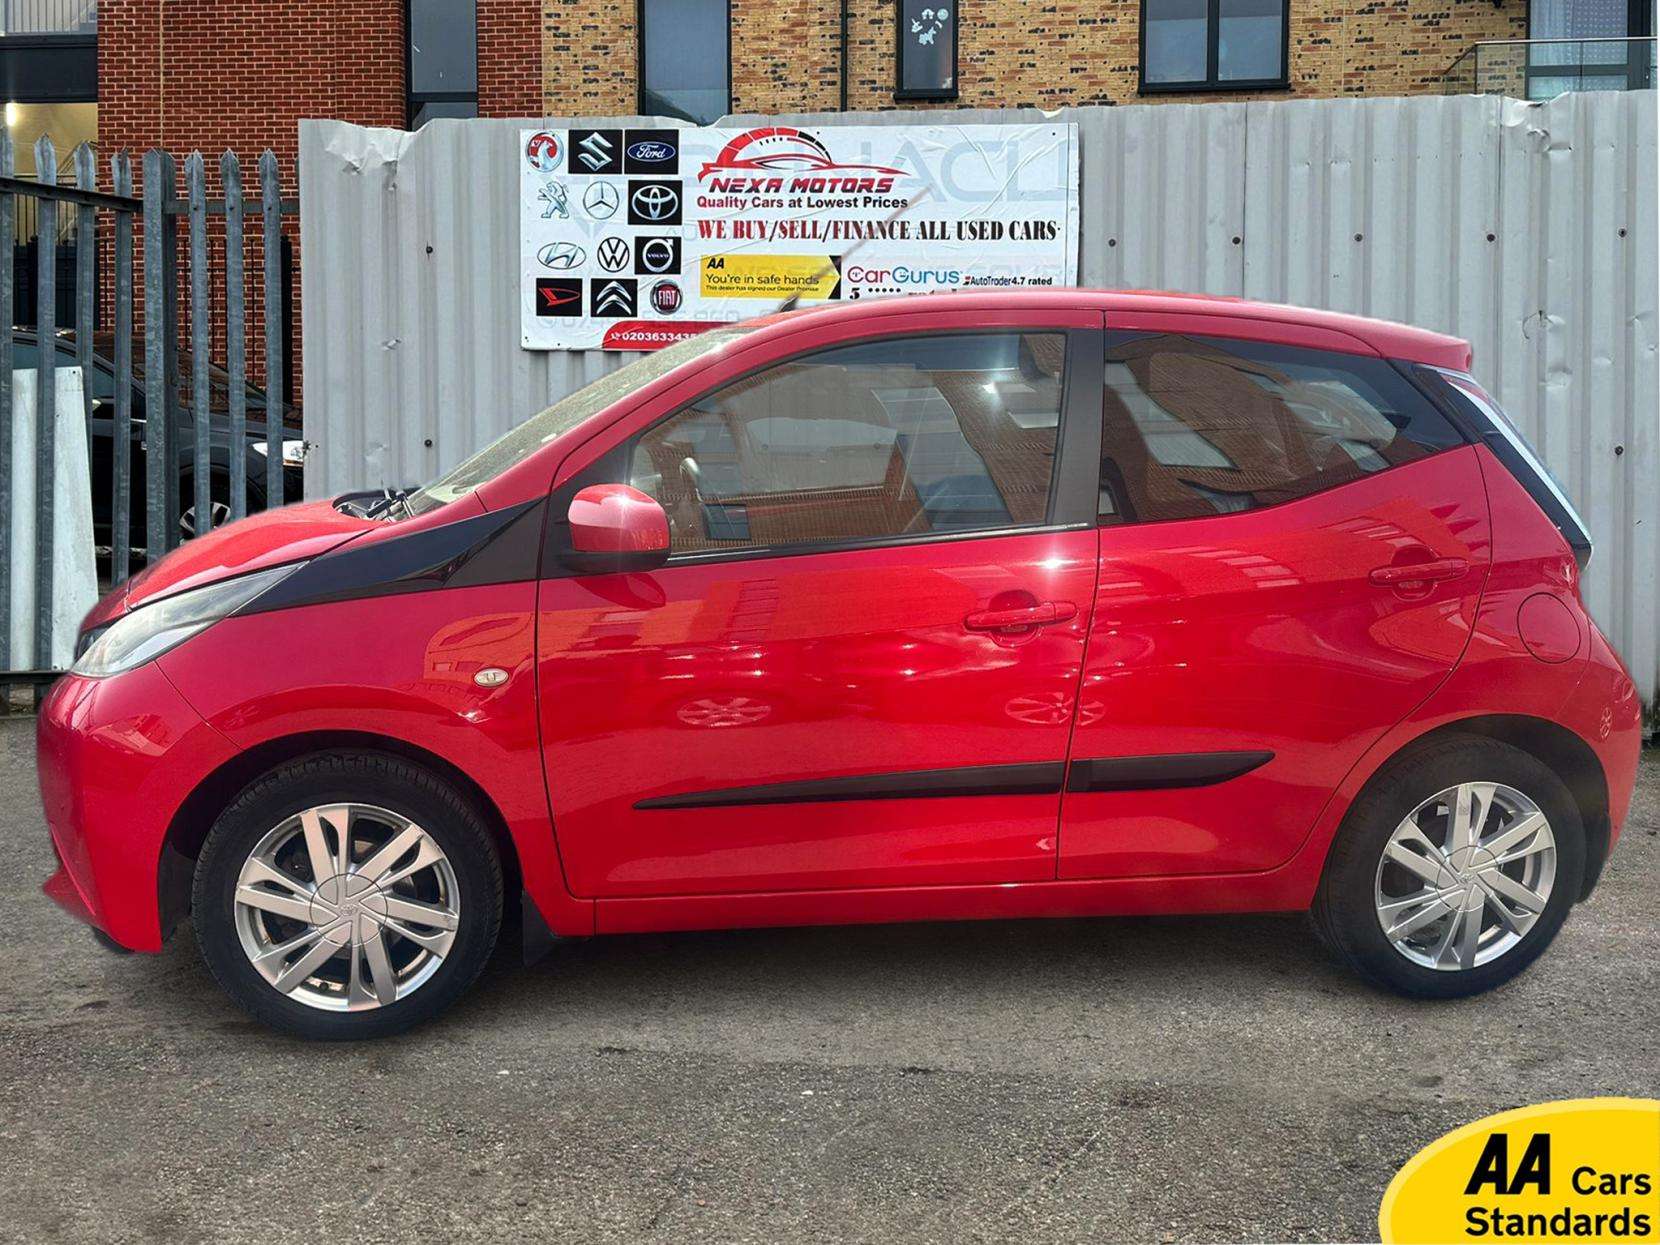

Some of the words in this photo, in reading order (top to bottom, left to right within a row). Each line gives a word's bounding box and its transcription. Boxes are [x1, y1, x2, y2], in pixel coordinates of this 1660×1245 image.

[636, 144, 666, 159] Ford
[709, 178, 784, 193] NEXA
[789, 178, 895, 193] MOTORS
[697, 196, 748, 210] Quality
[752, 196, 784, 208] Cars
[788, 197, 802, 208] at
[807, 196, 859, 208] Lowest
[863, 196, 908, 208] Prices
[698, 220, 727, 240] WE
[916, 220, 951, 240] ALL
[956, 220, 1004, 240] USED
[1008, 220, 1057, 240] CARS
[707, 258, 725, 269] AA
[706, 274, 741, 284] You're
[744, 274, 754, 284] in
[757, 274, 781, 285] safe
[784, 275, 819, 285] hands
[847, 266, 960, 284] CarGurus
[1028, 277, 1052, 285] rated
[658, 290, 676, 306] FIAT
[849, 287, 860, 300] 5
